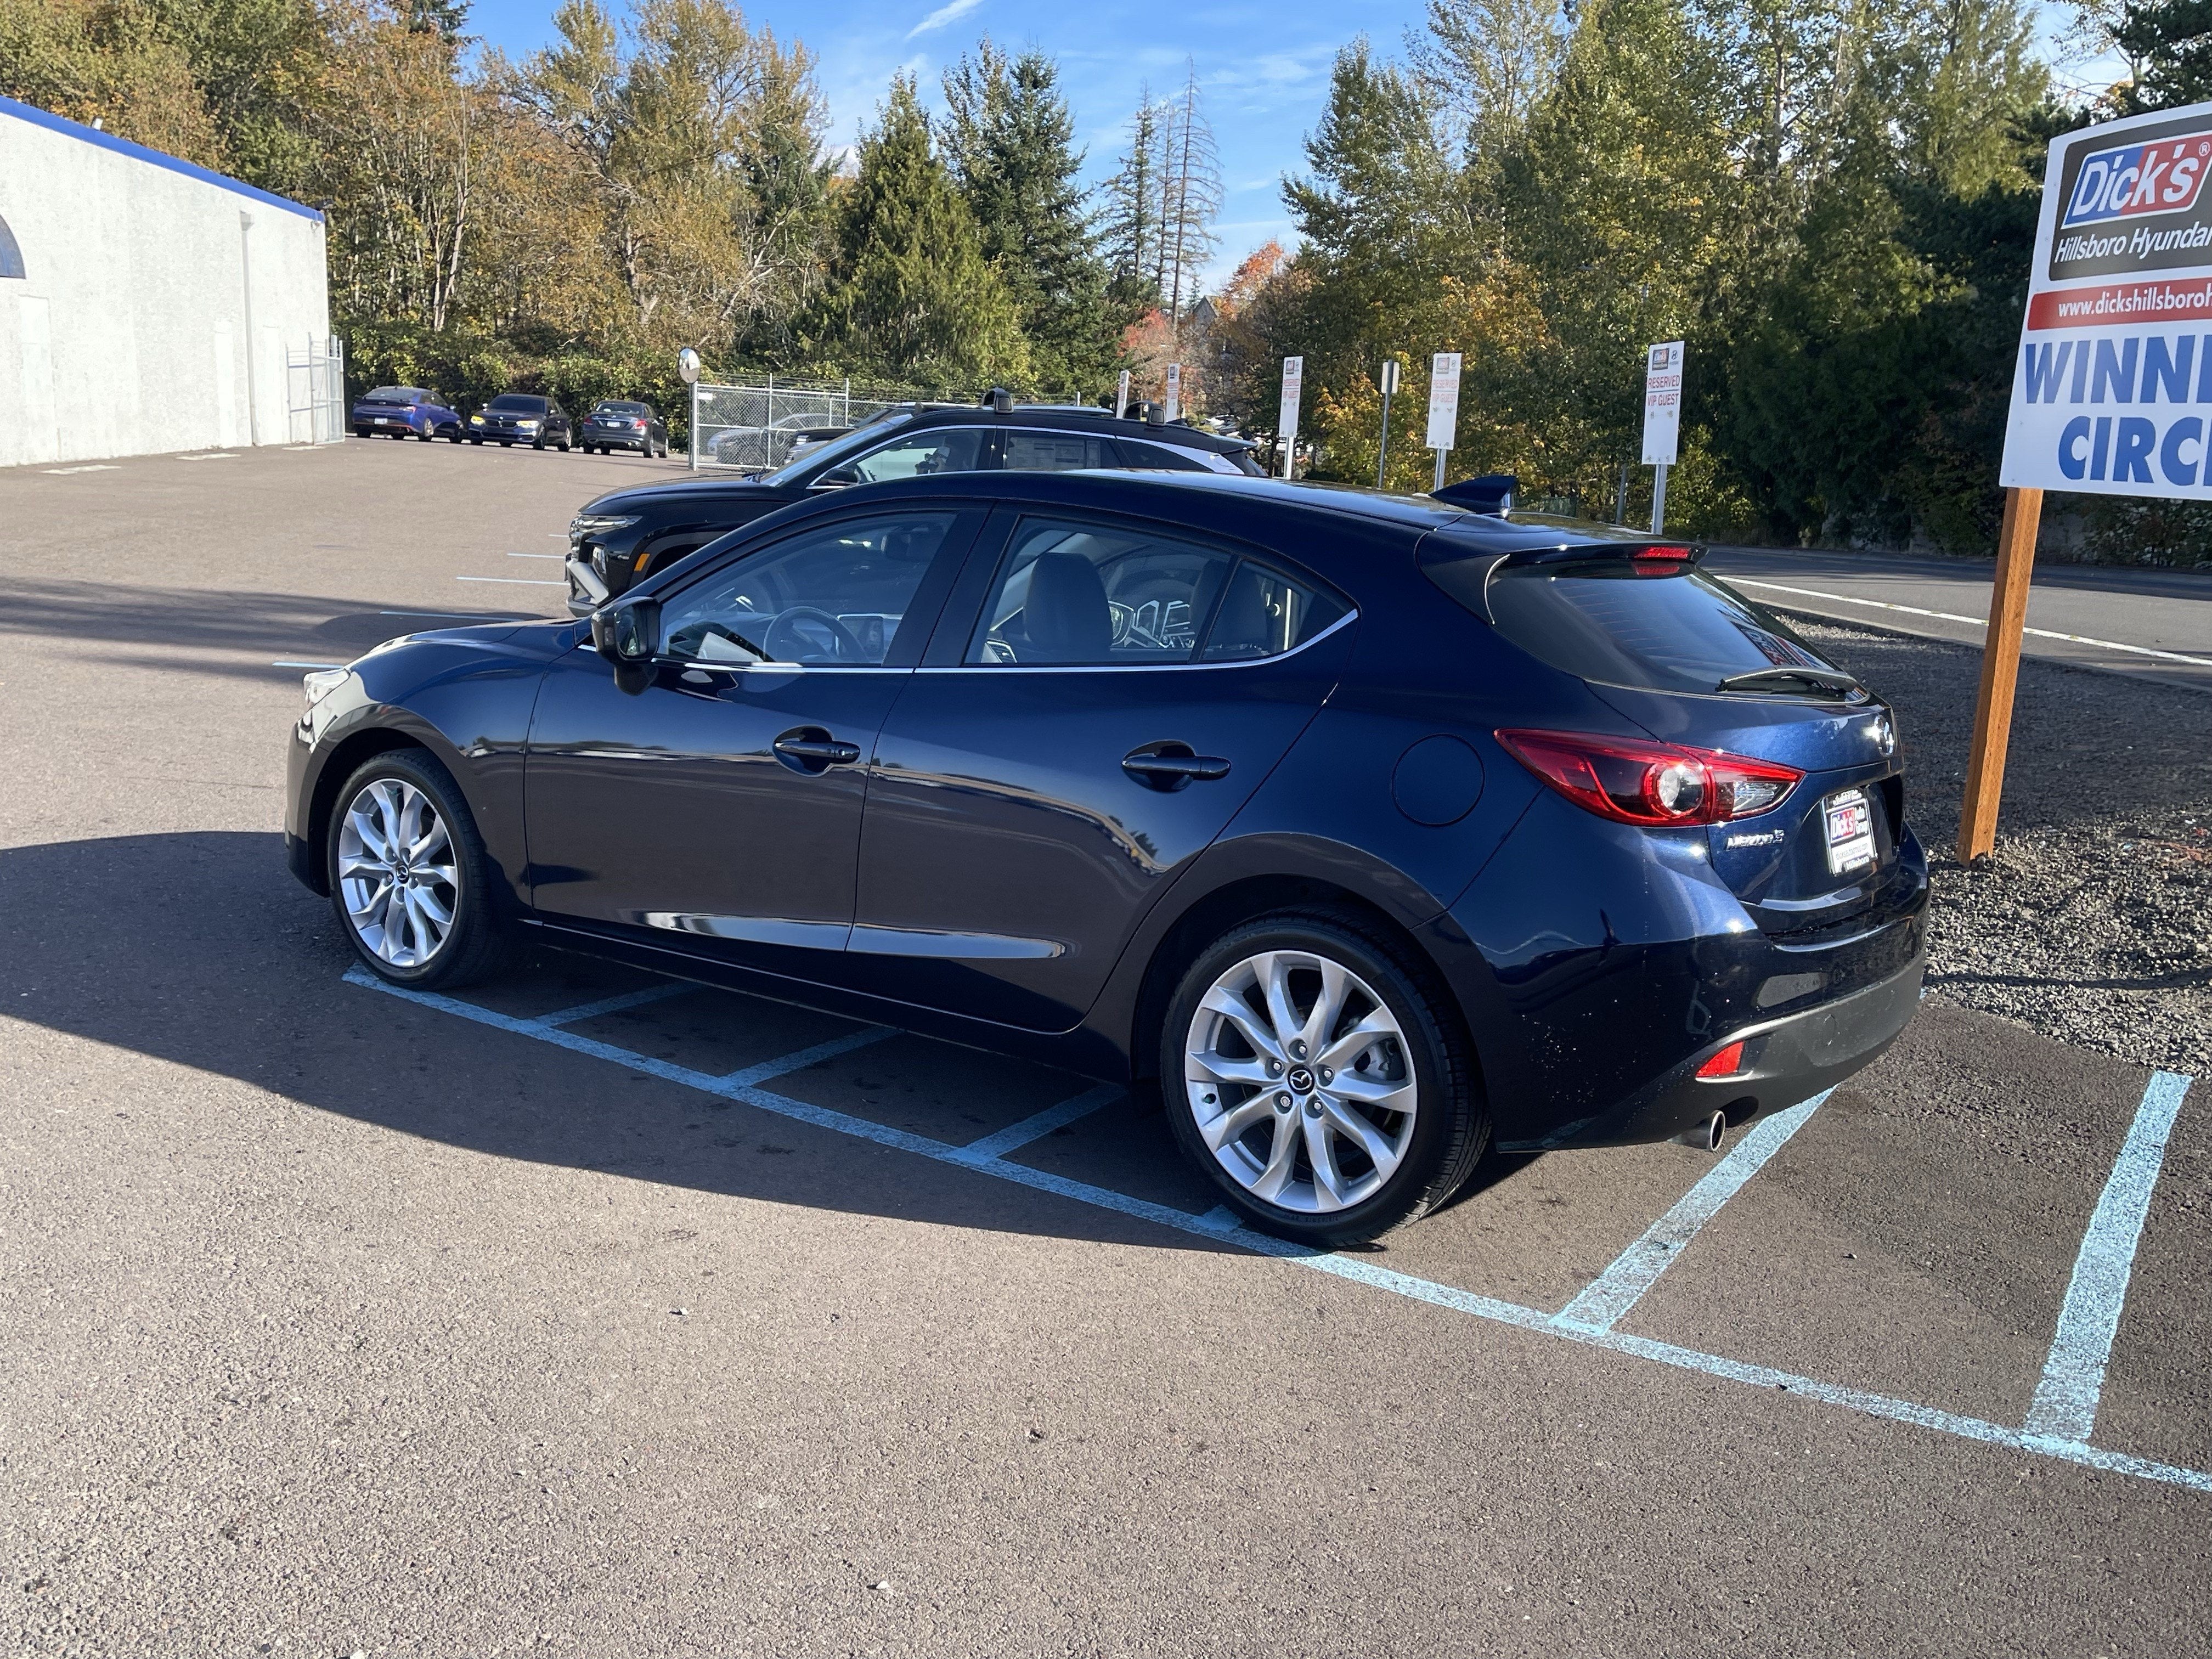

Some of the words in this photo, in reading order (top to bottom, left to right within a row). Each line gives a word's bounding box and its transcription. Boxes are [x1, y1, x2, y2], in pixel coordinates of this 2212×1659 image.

[2072, 144, 2199, 217] Dick's
[2055, 234, 2126, 263] Hillsboro
[1647, 375, 1680, 388] RESERVED
[1647, 395, 1657, 406] VIP
[1658, 393, 1679, 406] GUEST
[2058, 415, 2212, 487] CIRC
